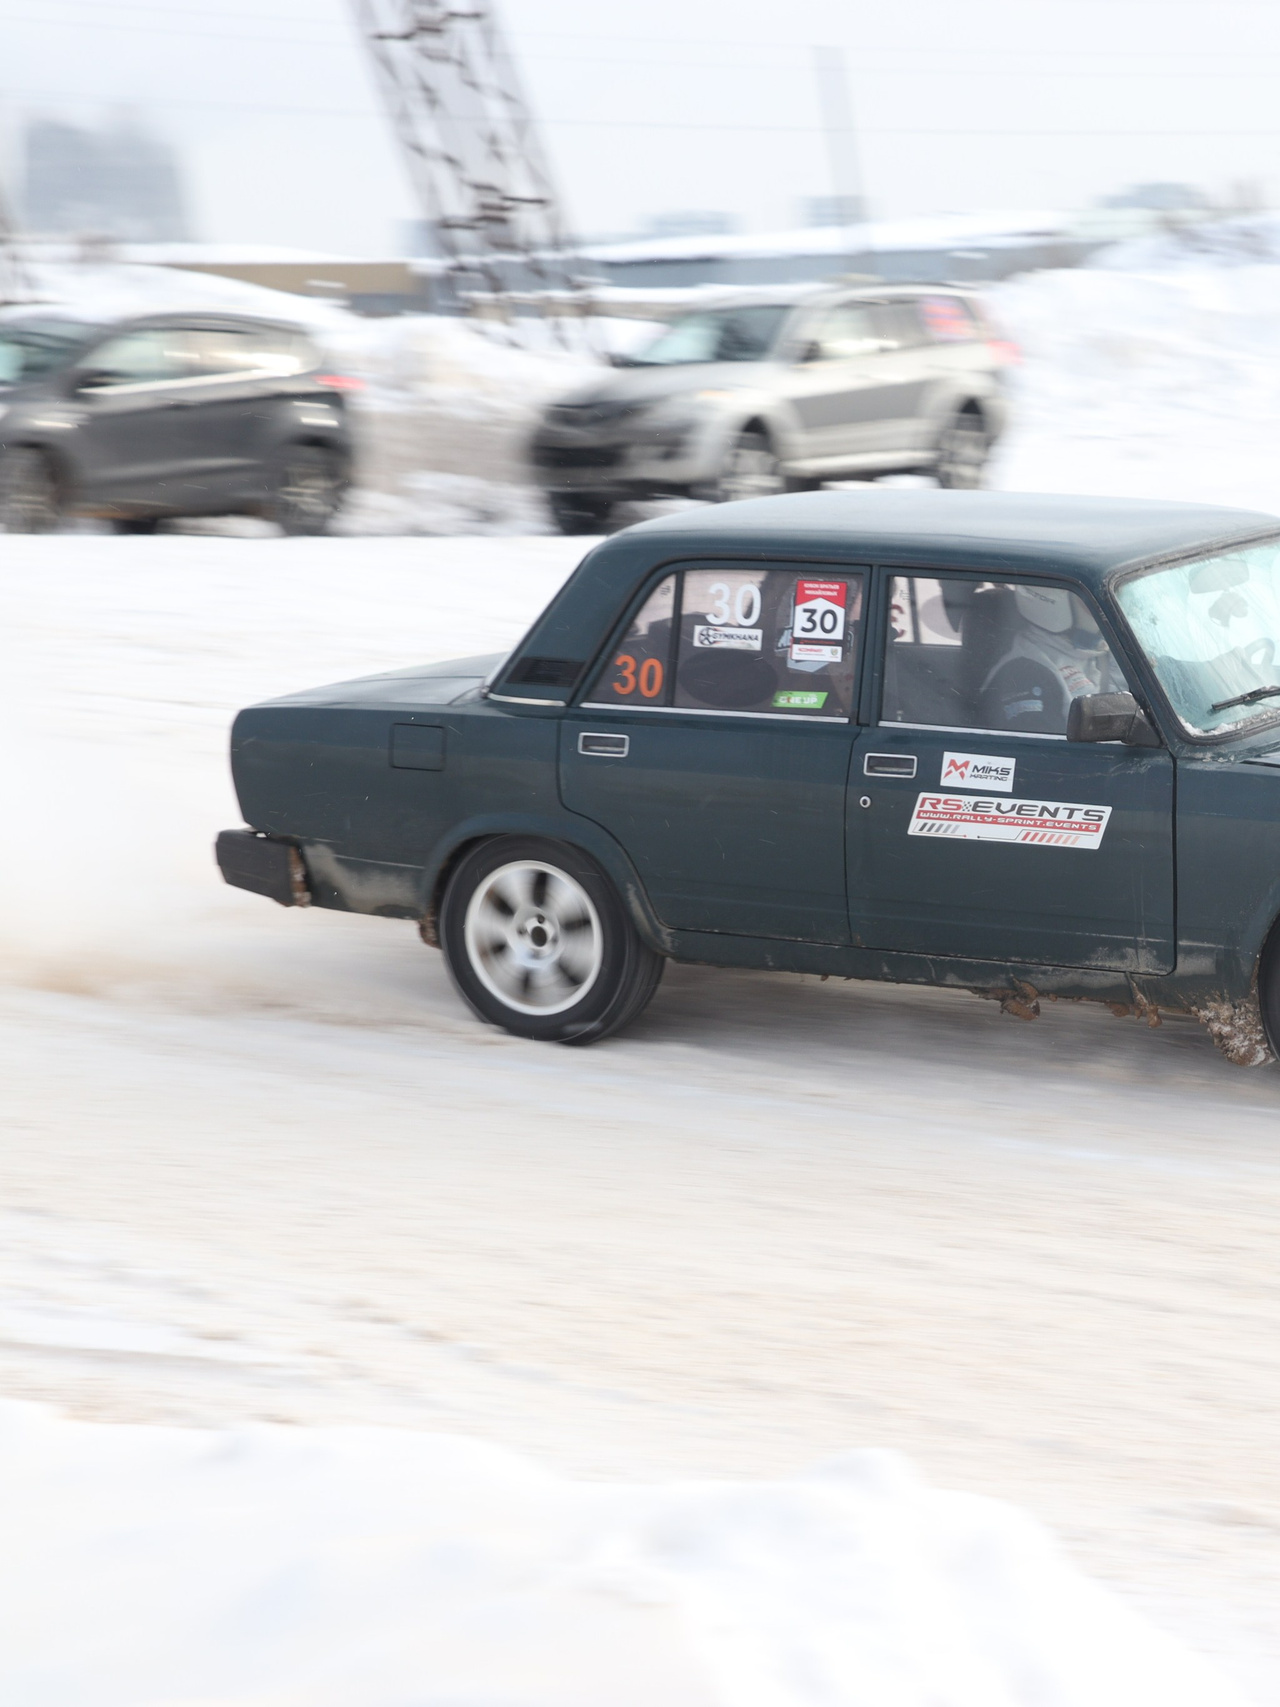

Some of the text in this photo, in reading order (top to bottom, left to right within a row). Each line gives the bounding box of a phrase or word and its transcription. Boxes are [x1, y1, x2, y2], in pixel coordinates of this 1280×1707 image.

[705, 582, 762, 627] 30
[800, 608, 838, 634] 30
[612, 655, 664, 698] 30
[972, 764, 1012, 776] MIKS
[919, 796, 1106, 822] RS EVENTS
